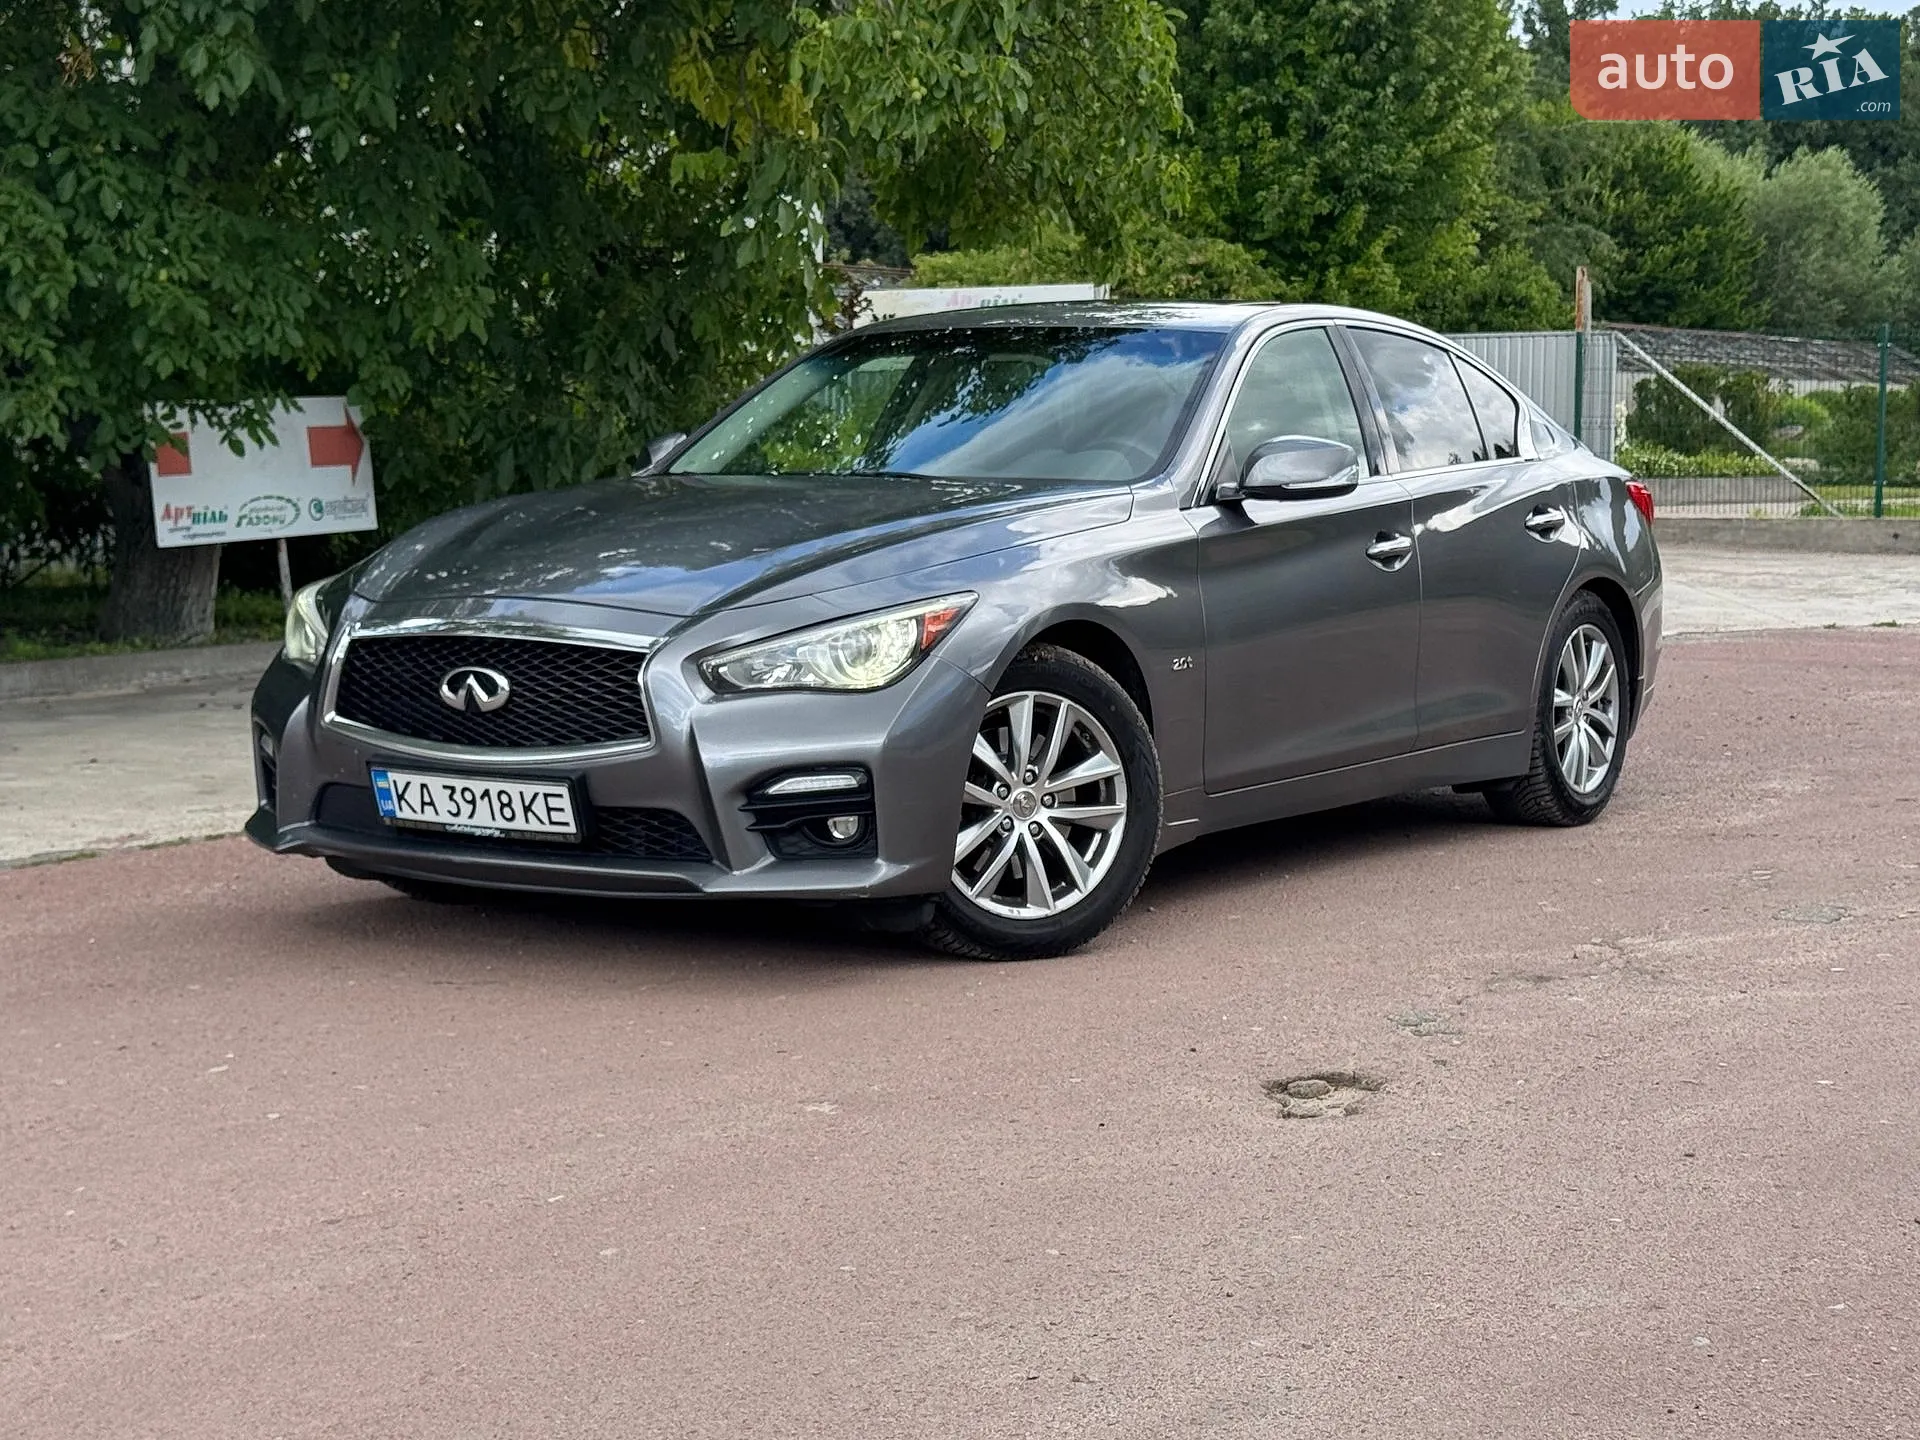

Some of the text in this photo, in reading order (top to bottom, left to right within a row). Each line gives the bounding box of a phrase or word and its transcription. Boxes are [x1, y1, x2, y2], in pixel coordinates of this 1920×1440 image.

[380, 799, 395, 811] UA
[392, 779, 571, 827] KA 3918 KE
